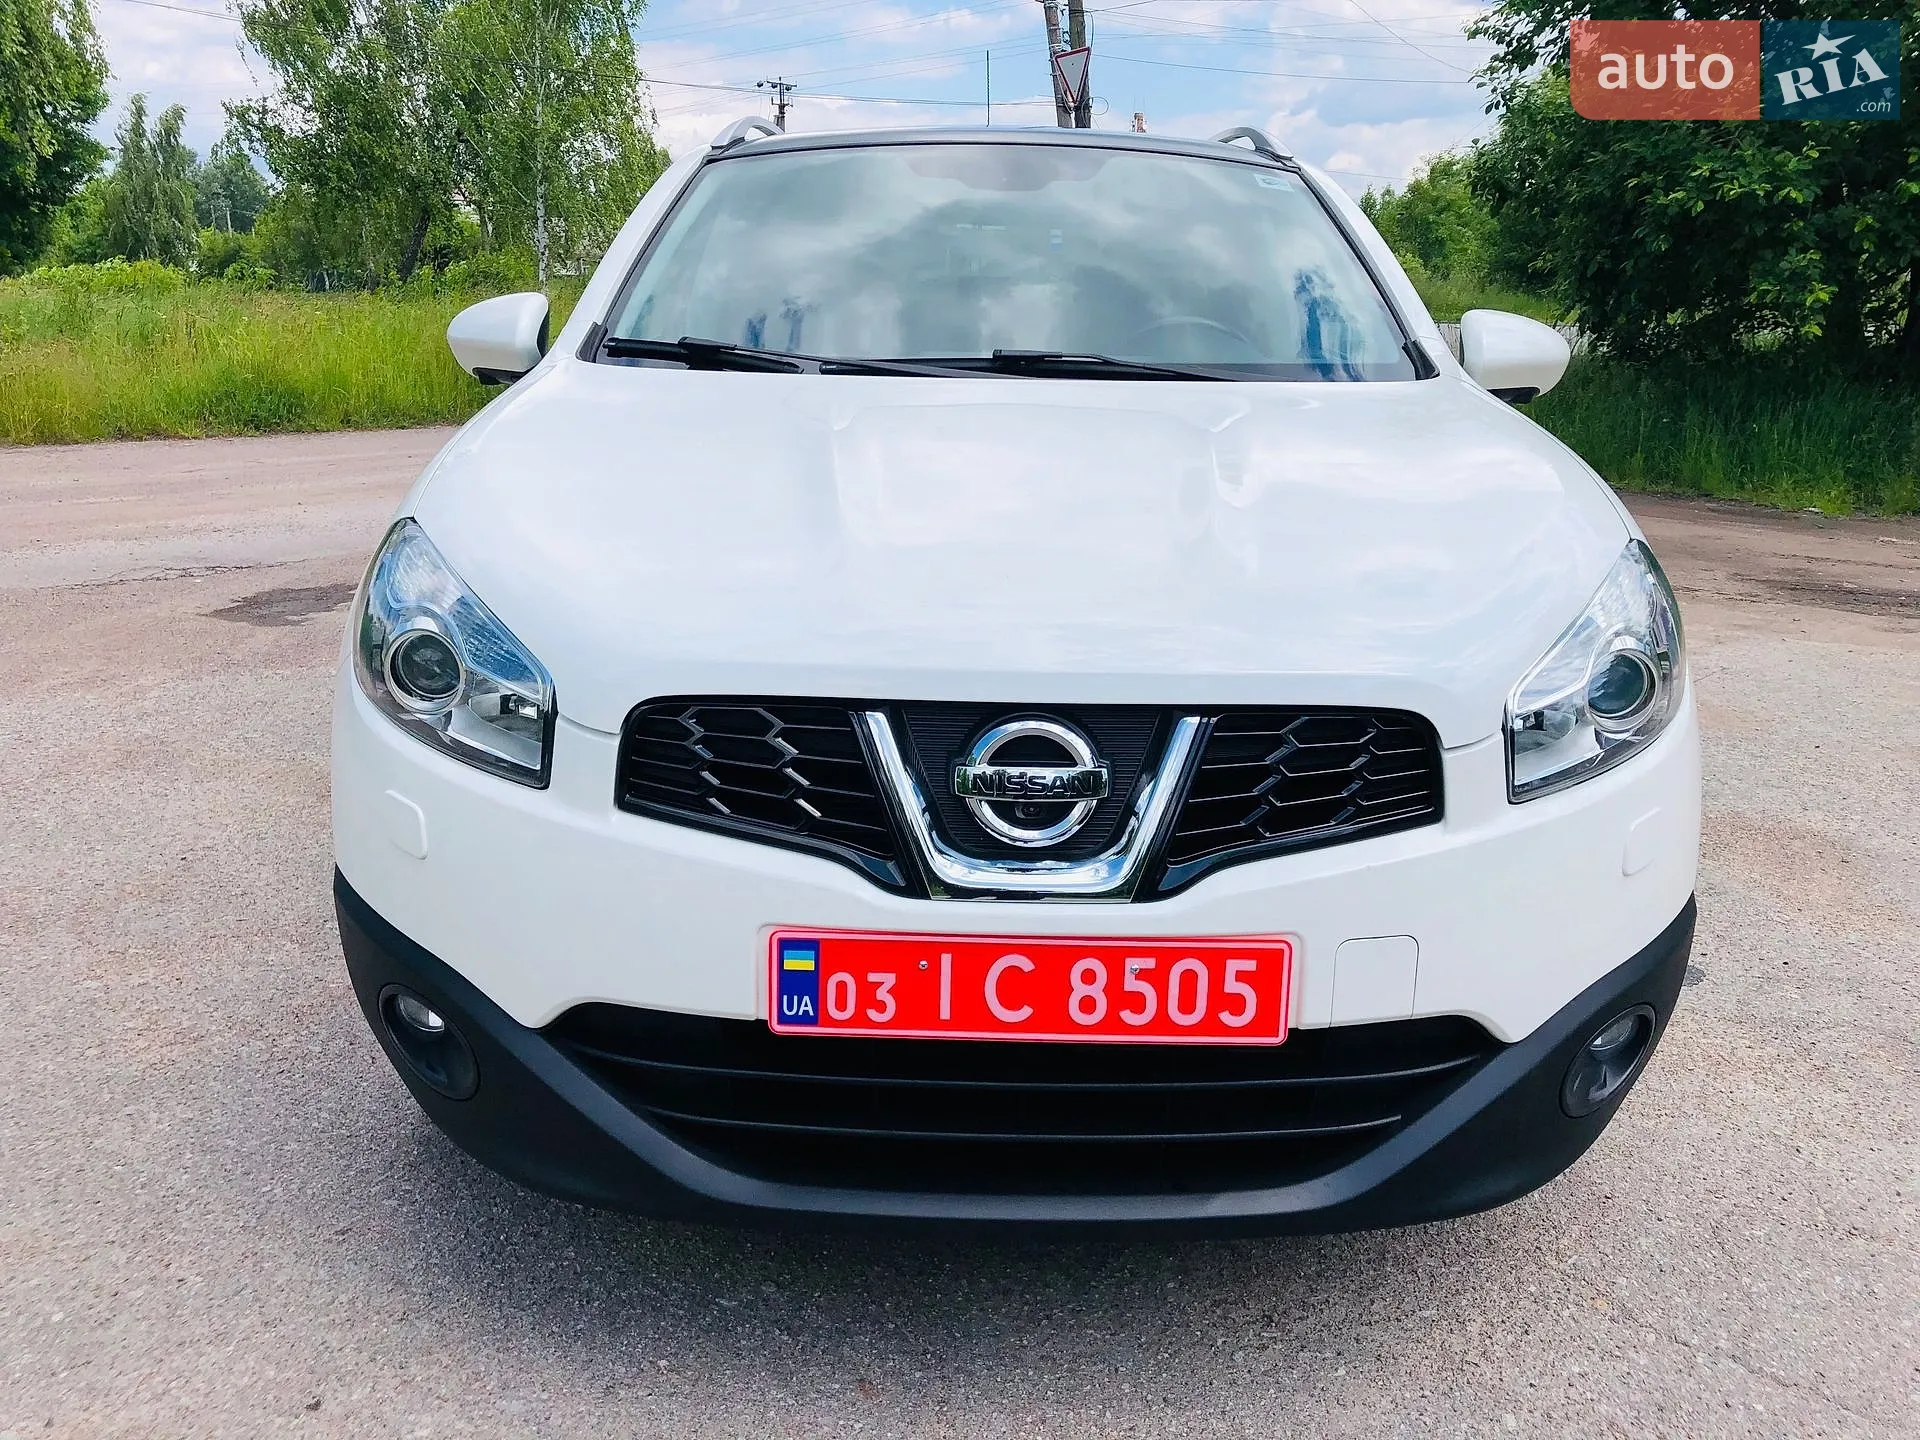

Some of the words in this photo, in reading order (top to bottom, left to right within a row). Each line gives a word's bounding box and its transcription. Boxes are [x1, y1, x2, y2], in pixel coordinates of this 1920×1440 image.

[971, 772, 1094, 795] NISSAN
[826, 972, 897, 1023] 03
[1068, 957, 1258, 1028] 8505
[783, 995, 814, 1017] UA
